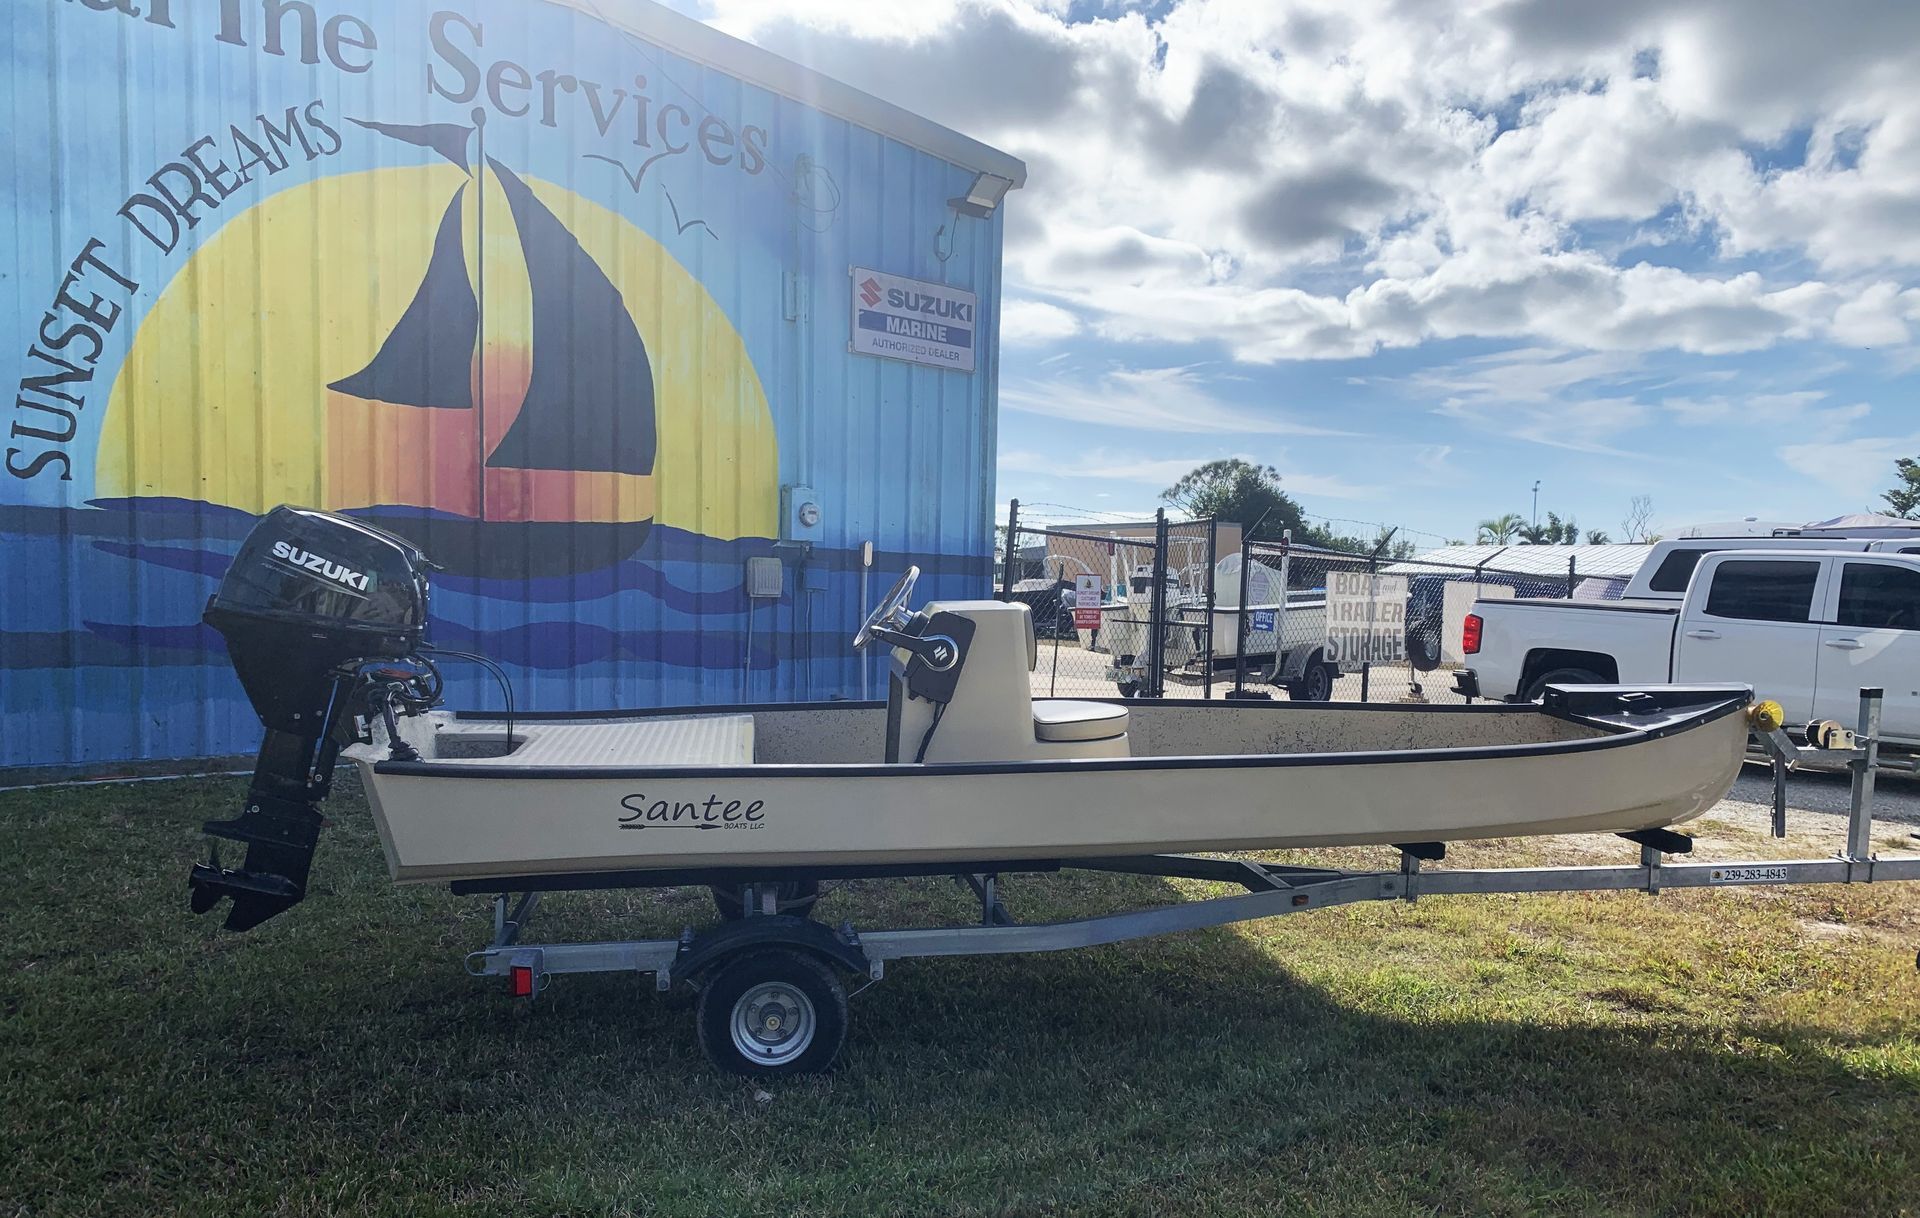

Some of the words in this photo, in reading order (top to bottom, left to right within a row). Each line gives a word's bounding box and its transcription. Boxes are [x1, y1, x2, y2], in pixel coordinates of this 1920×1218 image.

[427, 10, 769, 175] Services
[6, 237, 139, 481] SUNSET
[117, 99, 343, 256] DREAMS
[887, 288, 972, 323] SUZUKI
[886, 316, 947, 343] MARINE
[872, 337, 927, 355] AUTHORIZED
[929, 347, 960, 361] DEALER
[272, 541, 369, 592] SUZUKI
[1335, 573, 1384, 597] BOAT
[1382, 581, 1397, 592] and
[1255, 611, 1273, 623] OFFICE
[1326, 625, 1403, 661] STORAGE
[618, 793, 765, 823] Santee
[723, 822, 748, 830] BOATS
[749, 822, 765, 830] LLC
[1724, 868, 1787, 881] 239-283-4843
